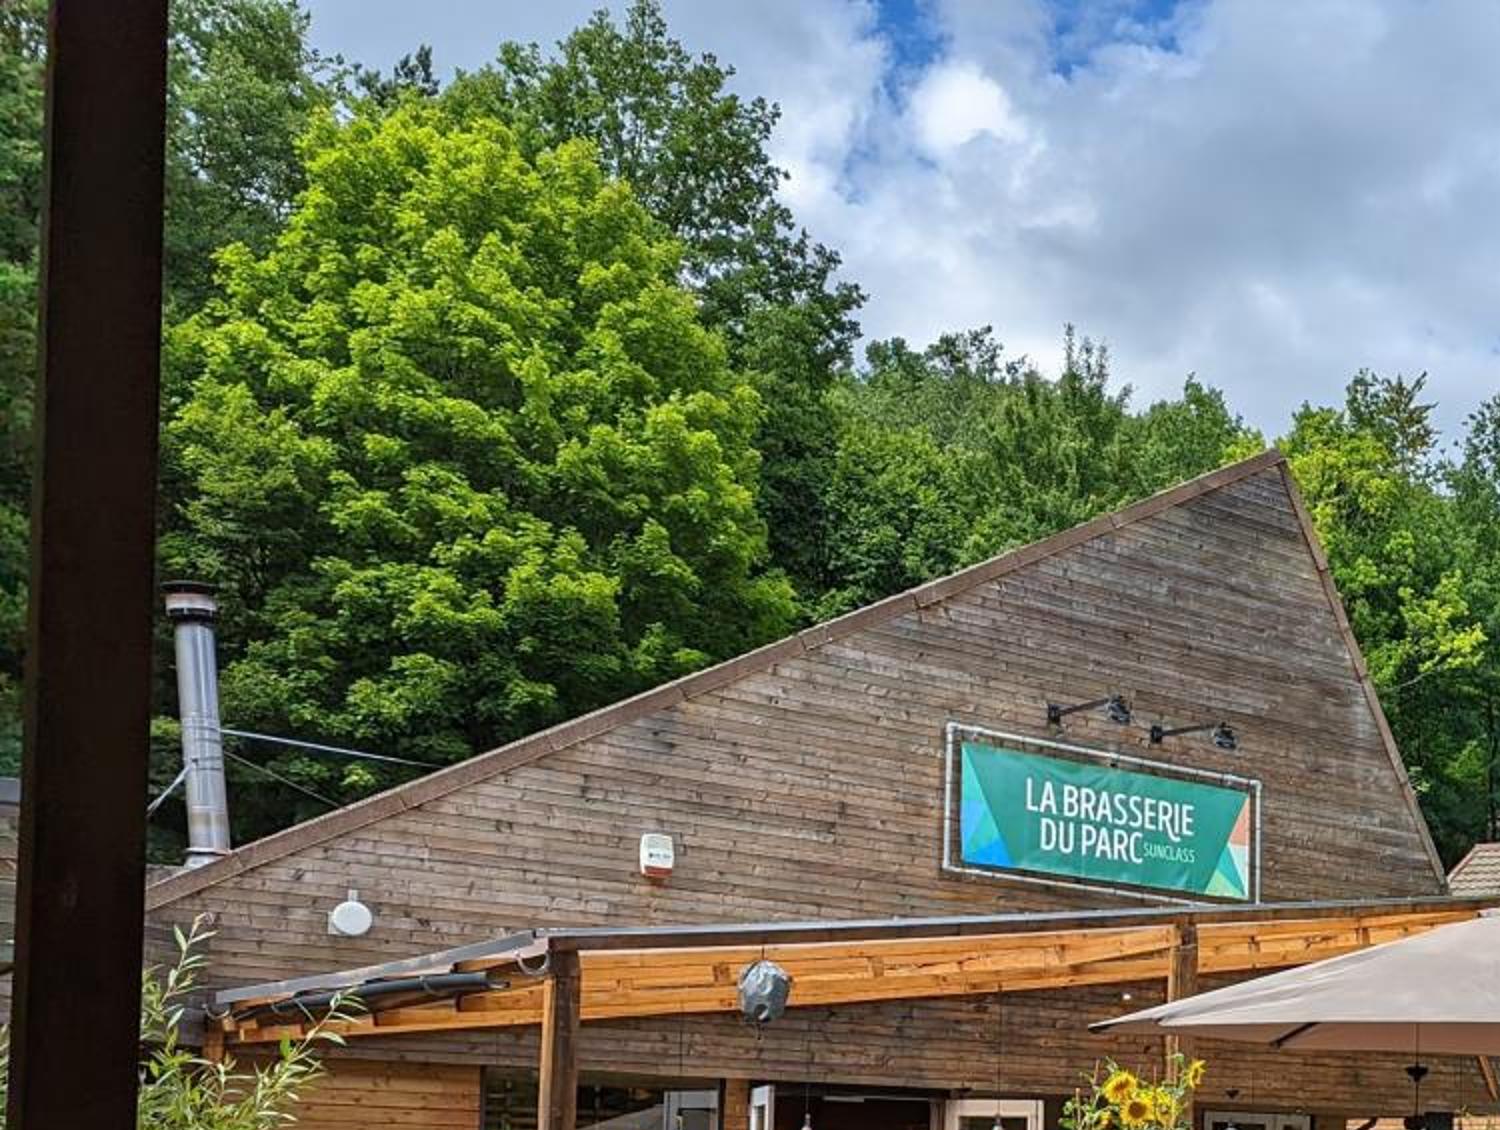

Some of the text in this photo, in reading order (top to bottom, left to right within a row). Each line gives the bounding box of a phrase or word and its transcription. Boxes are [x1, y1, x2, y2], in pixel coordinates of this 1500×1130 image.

[1026, 777, 1195, 842] LA BRASSERIE
[1040, 818, 1143, 864] DU PARC
[1143, 842, 1195, 863] SUNCLASS
